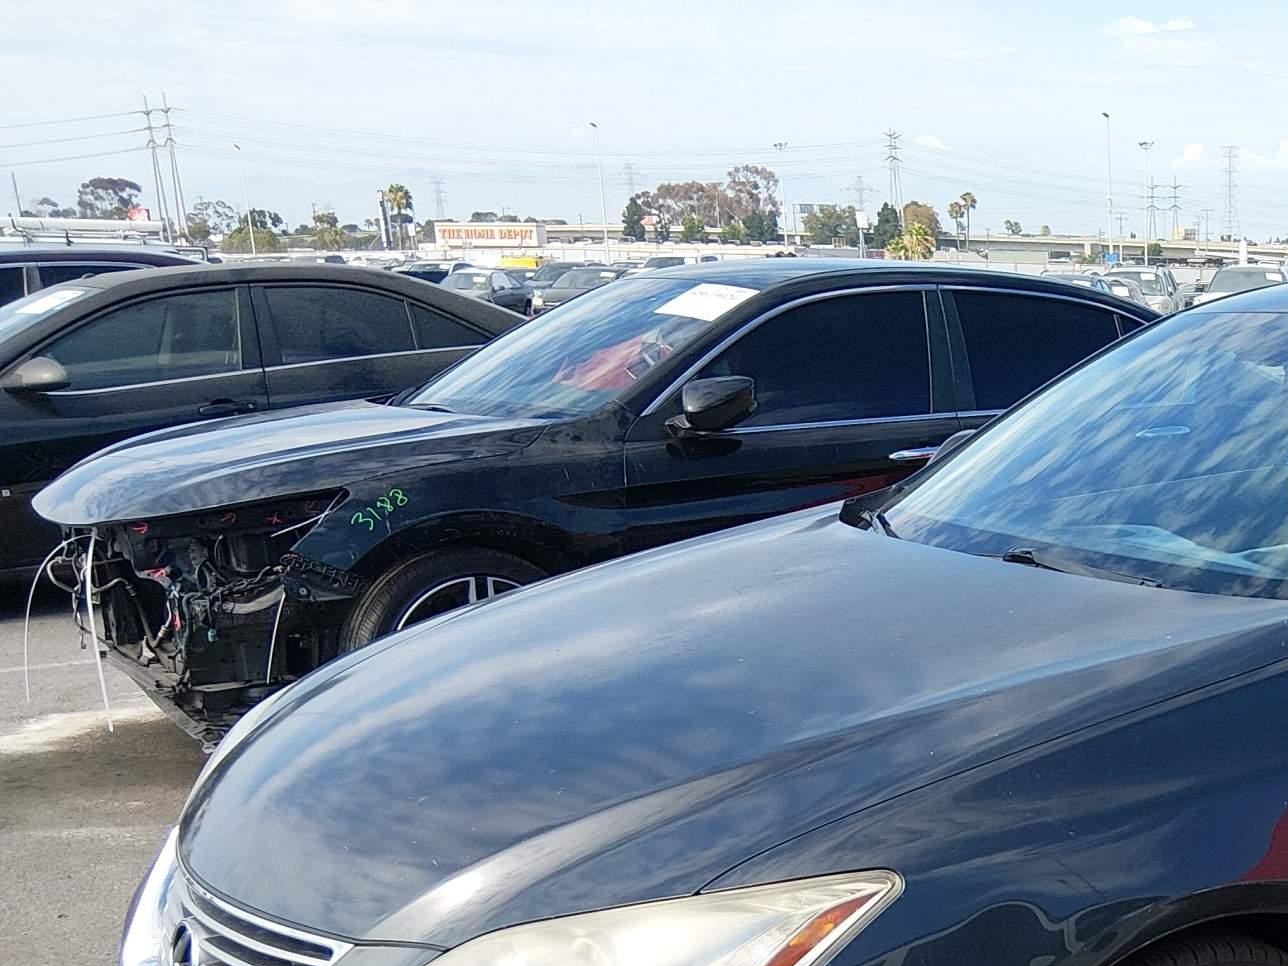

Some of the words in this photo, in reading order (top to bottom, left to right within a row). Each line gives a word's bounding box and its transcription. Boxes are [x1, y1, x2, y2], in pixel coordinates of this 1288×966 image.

[439, 228, 463, 240] THE
[464, 228, 496, 240] HOME
[498, 228, 534, 241] DEPOT
[350, 488, 409, 532] 3188
